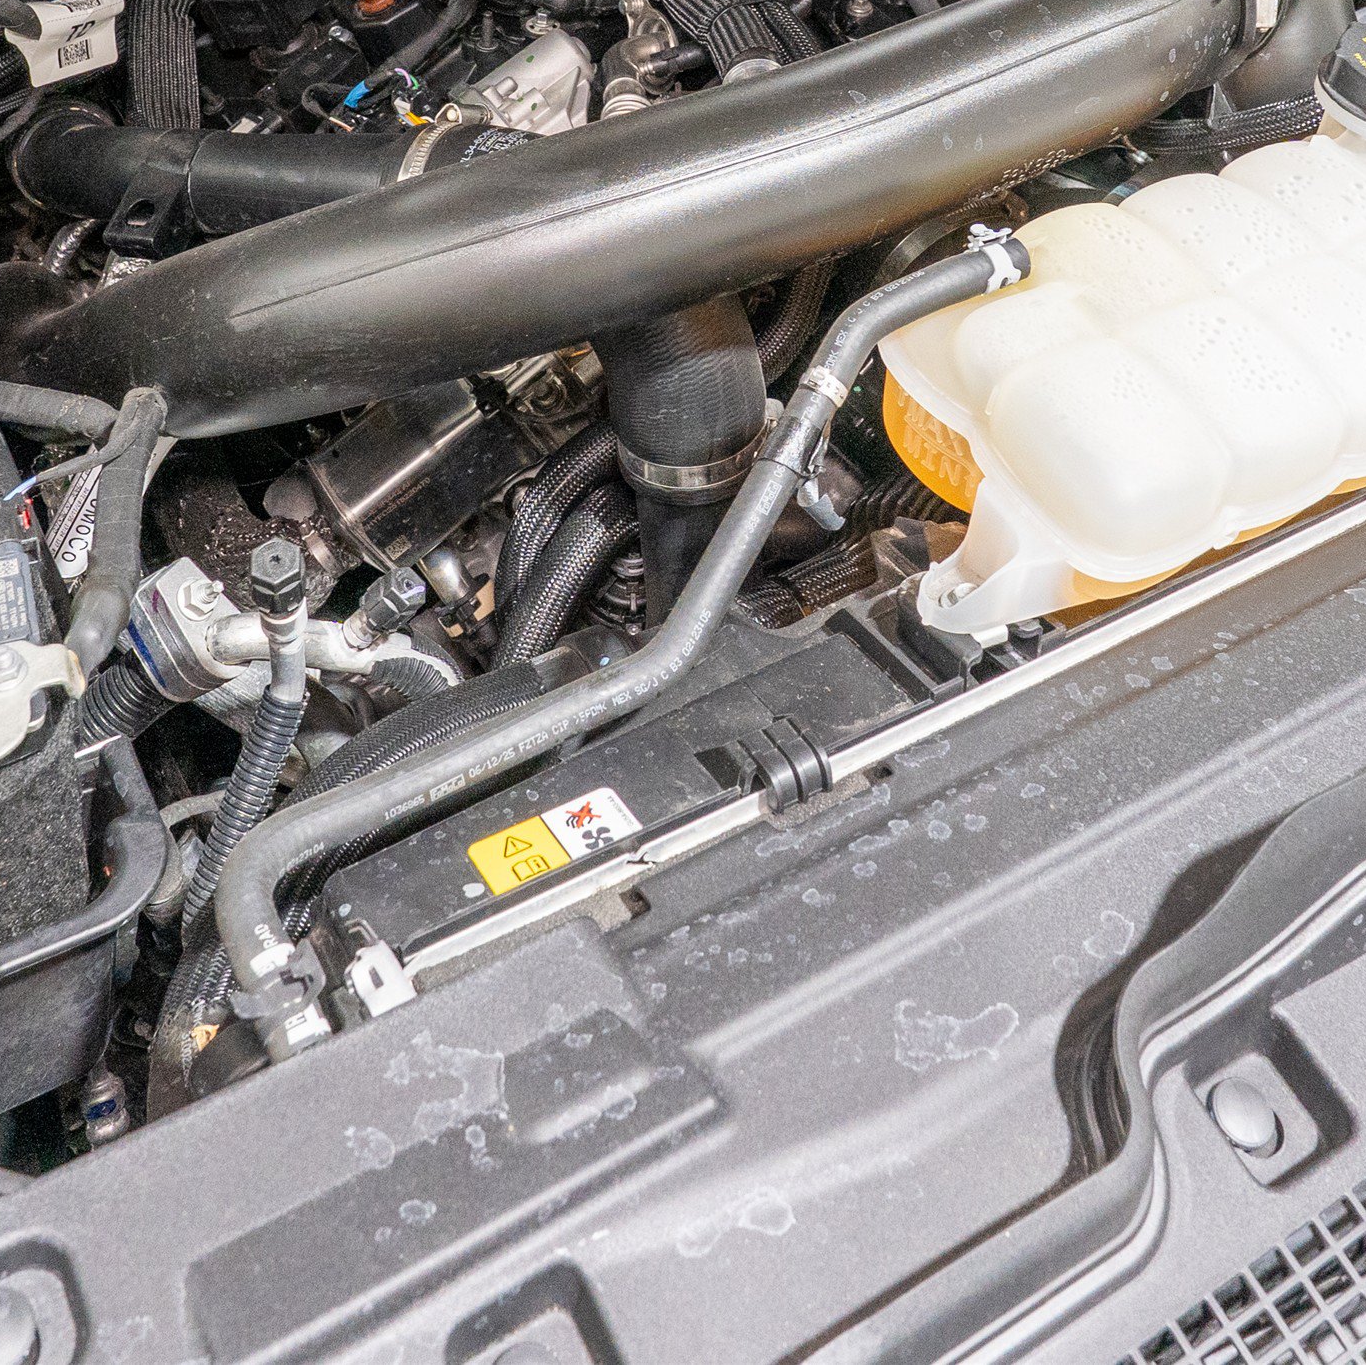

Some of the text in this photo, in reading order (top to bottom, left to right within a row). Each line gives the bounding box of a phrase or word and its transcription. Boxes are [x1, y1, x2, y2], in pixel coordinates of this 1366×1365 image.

[903, 425, 963, 487] MIN
[468, 750, 517, 779] 06/12/25
[612, 691, 633, 708] MEX
[660, 668, 670, 681] C
[669, 656, 684, 673] B3
[254, 923, 279, 950] RAD
